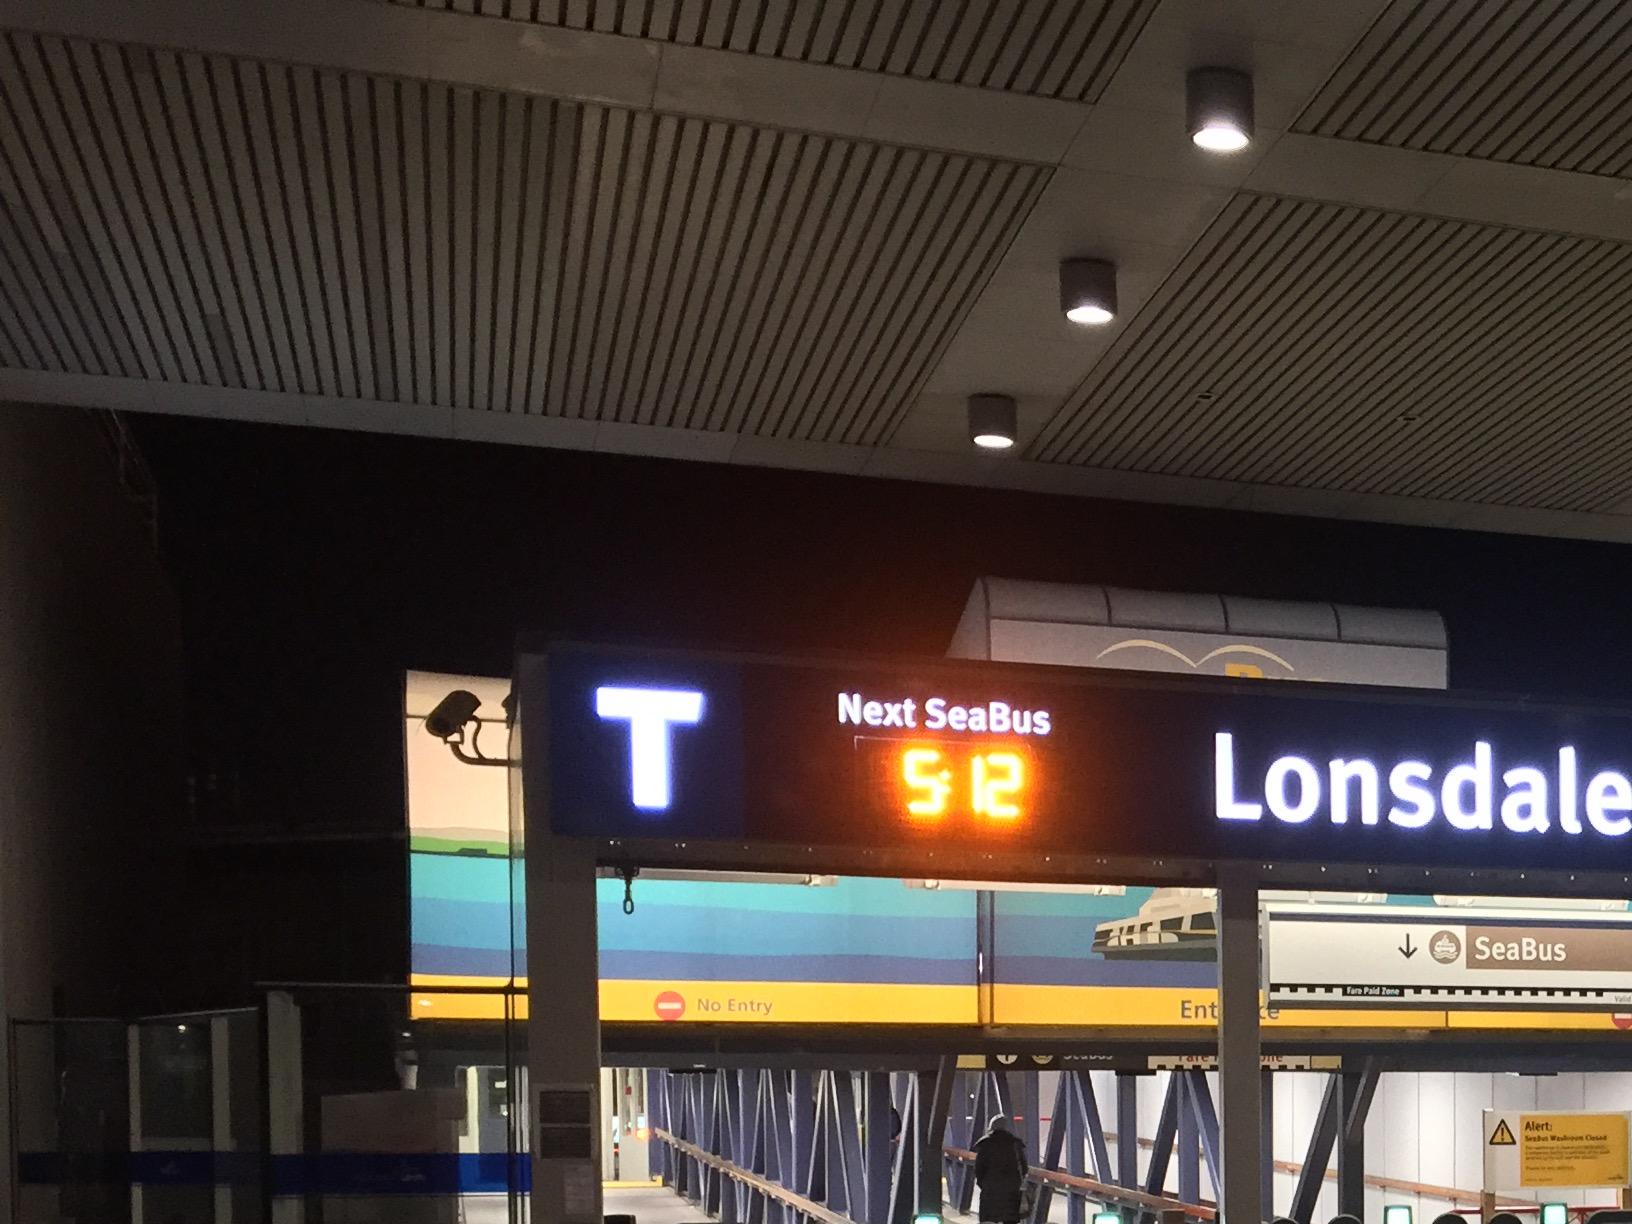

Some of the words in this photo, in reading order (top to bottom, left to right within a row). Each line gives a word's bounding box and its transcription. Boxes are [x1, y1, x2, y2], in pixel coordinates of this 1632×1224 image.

[837, 692, 917, 729] Next
[924, 698, 1052, 736] SeaBus
[596, 686, 704, 809] T
[1474, 935, 1567, 962] SeaBus
[697, 998, 722, 1012] No
[727, 998, 773, 1016] Entry
[1524, 1120, 1553, 1132] Alert:
